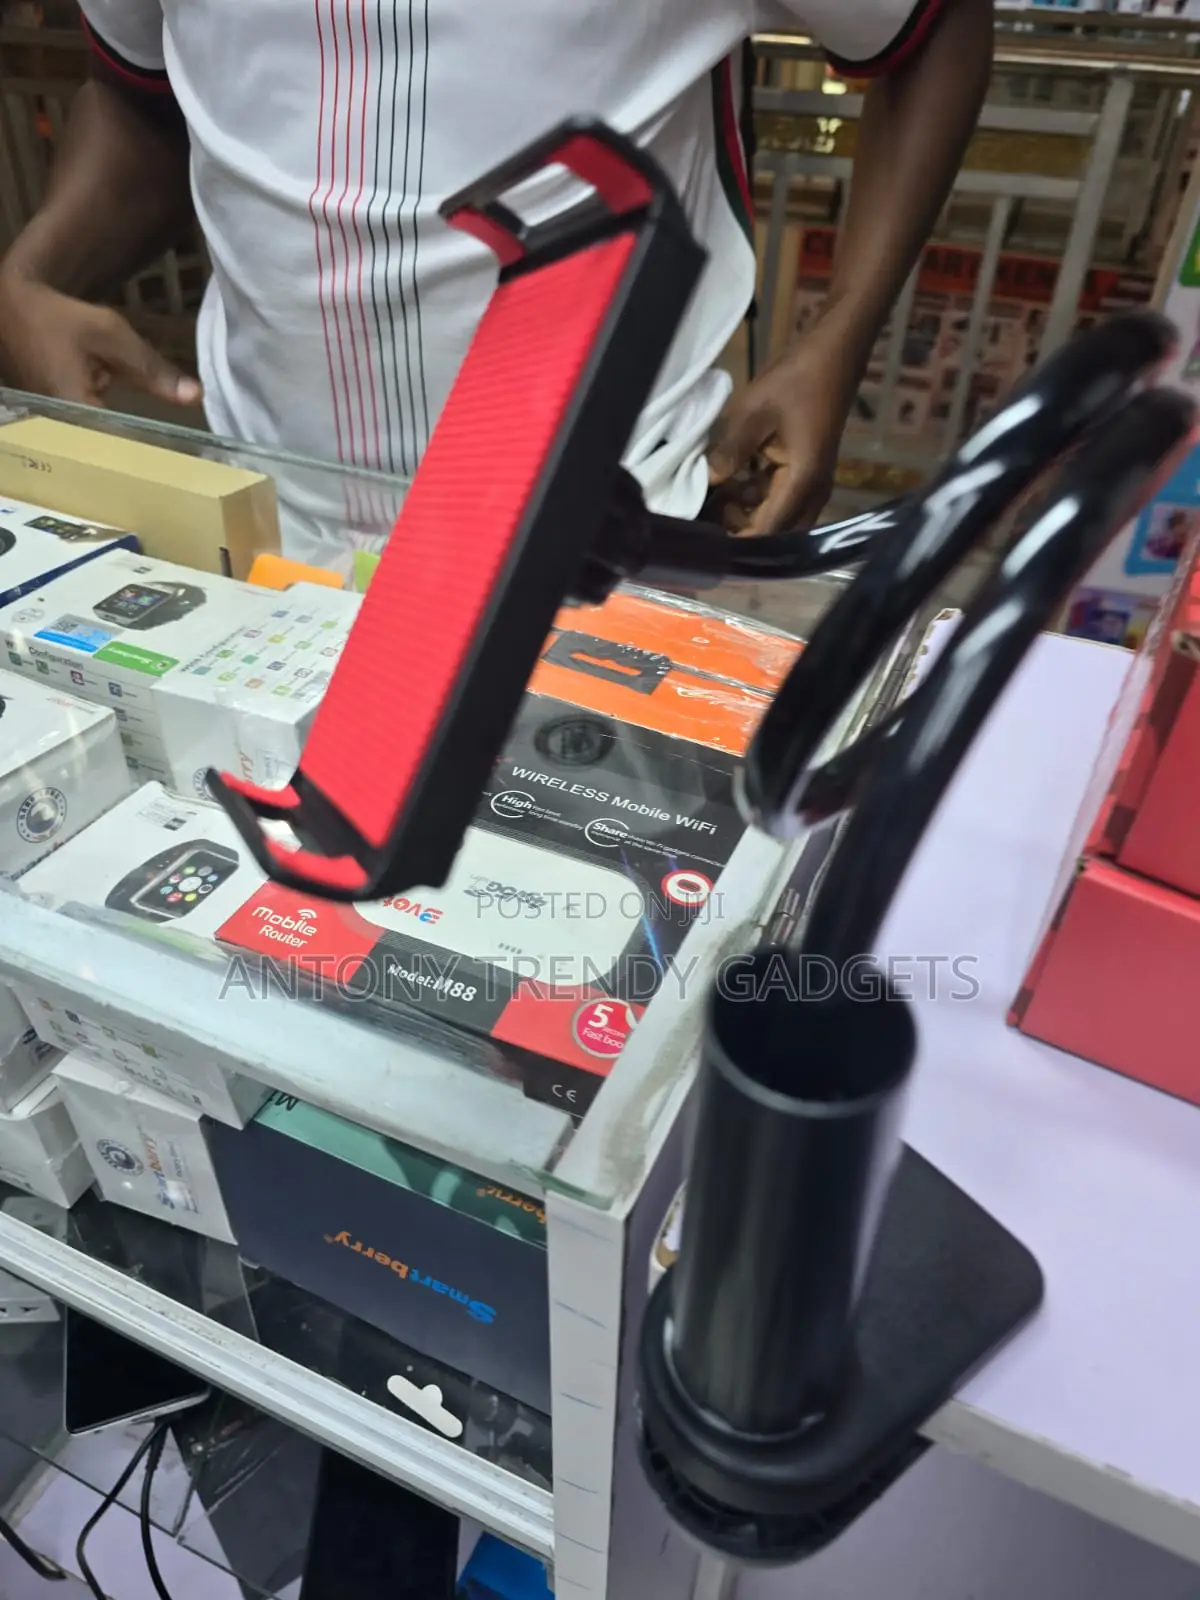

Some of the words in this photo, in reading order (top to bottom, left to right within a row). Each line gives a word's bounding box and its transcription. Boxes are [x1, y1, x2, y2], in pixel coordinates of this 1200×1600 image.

[501, 794, 533, 811] High
[511, 765, 610, 803] WIRELESS
[611, 796, 671, 822] Mobile
[675, 813, 718, 836] WiFi
[592, 822, 628, 839] Share
[258, 924, 307, 949] Router
[387, 963, 478, 1003] Model:M88
[587, 1003, 614, 1028] 5
[582, 1027, 602, 1043] Fast
[602, 1033, 624, 1049] boo
[332, 1230, 498, 1325] Smartberry
